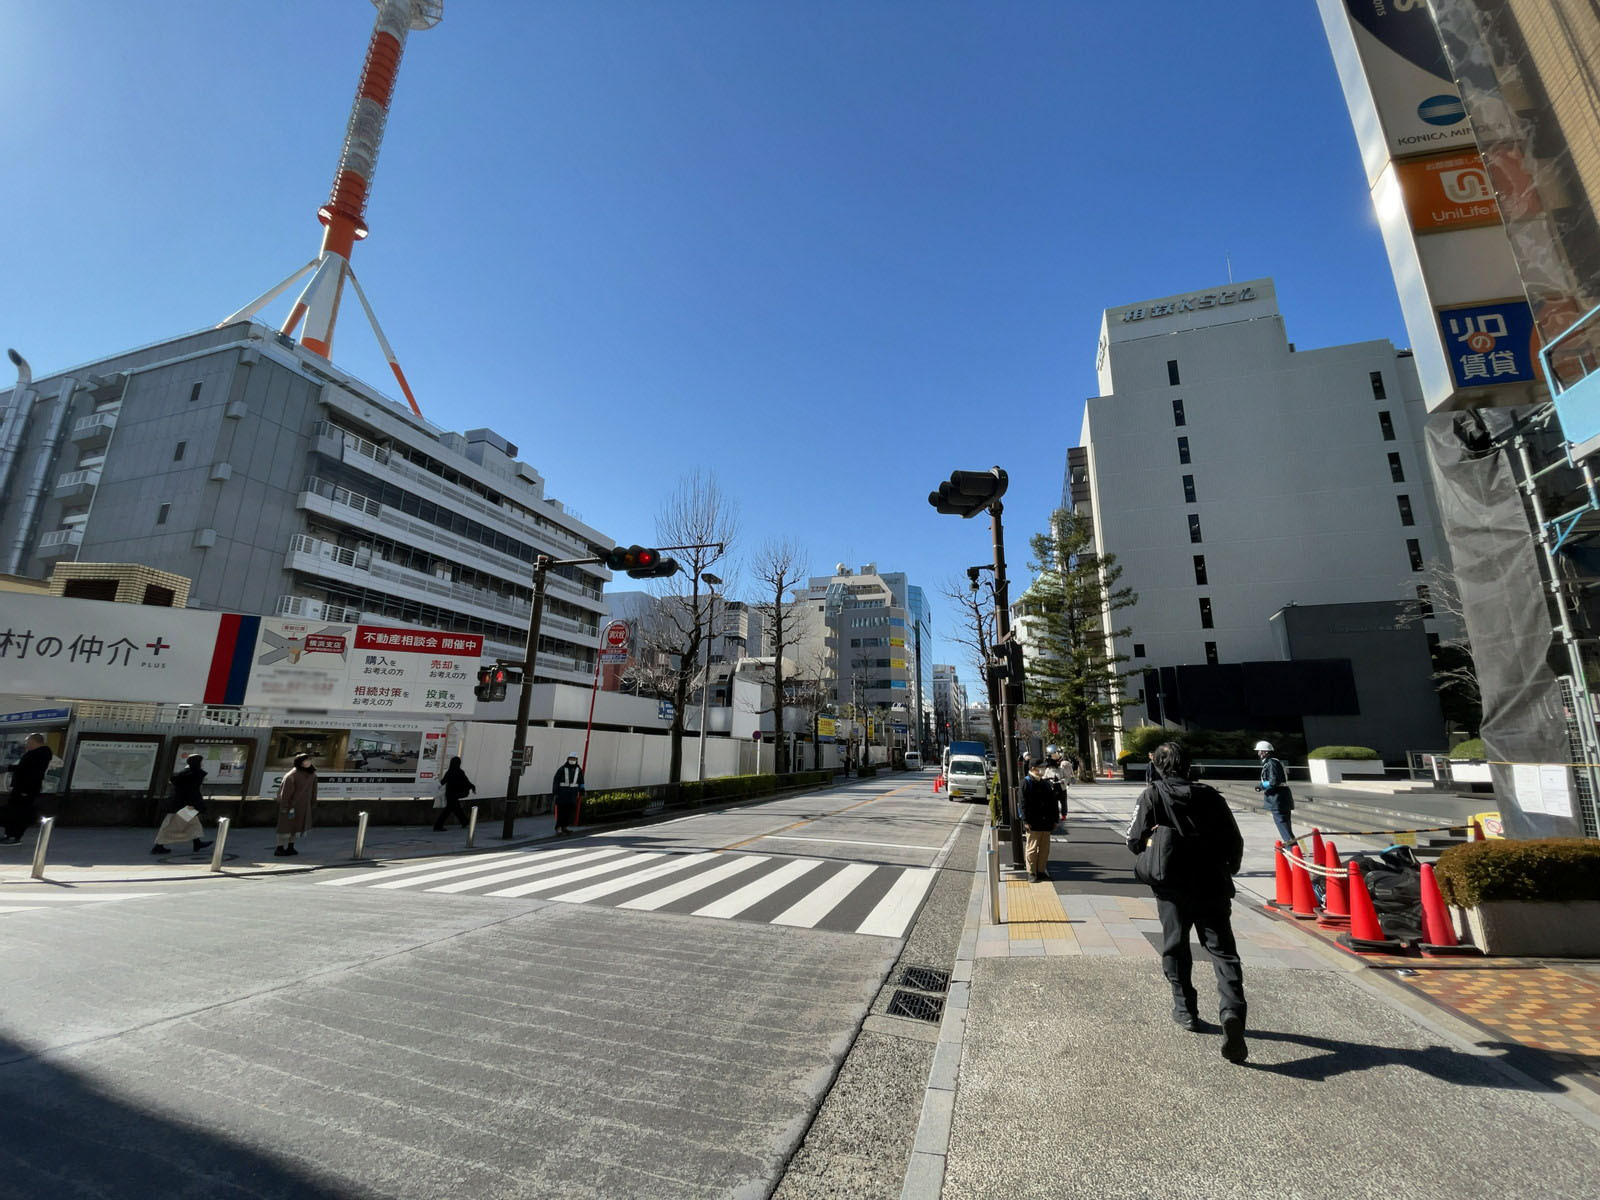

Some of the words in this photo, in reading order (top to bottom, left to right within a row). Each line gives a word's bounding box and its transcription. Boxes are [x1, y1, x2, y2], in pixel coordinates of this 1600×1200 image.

[1398, 132, 1448, 146] KONICA
[1431, 205, 1490, 222] UniLife
[1122, 287, 1257, 323] 相鉄KSビル
[1449, 313, 1508, 343] リロ
[1472, 335, 1491, 349] の
[1460, 350, 1520, 380] 賃貸
[363, 632, 438, 648] 不動産相談会
[441, 638, 477, 651] 開催中
[141, 661, 167, 669] PLUS
[365, 655, 397, 667] 購入を
[430, 660, 459, 670] 売却を
[363, 667, 404, 676] お考えの方
[429, 671, 467, 680] お考えの方
[354, 686, 410, 698] 相続対策を
[426, 689, 455, 700] 投資を
[352, 698, 394, 707] お考えの方
[424, 701, 464, 709] お考えの方
